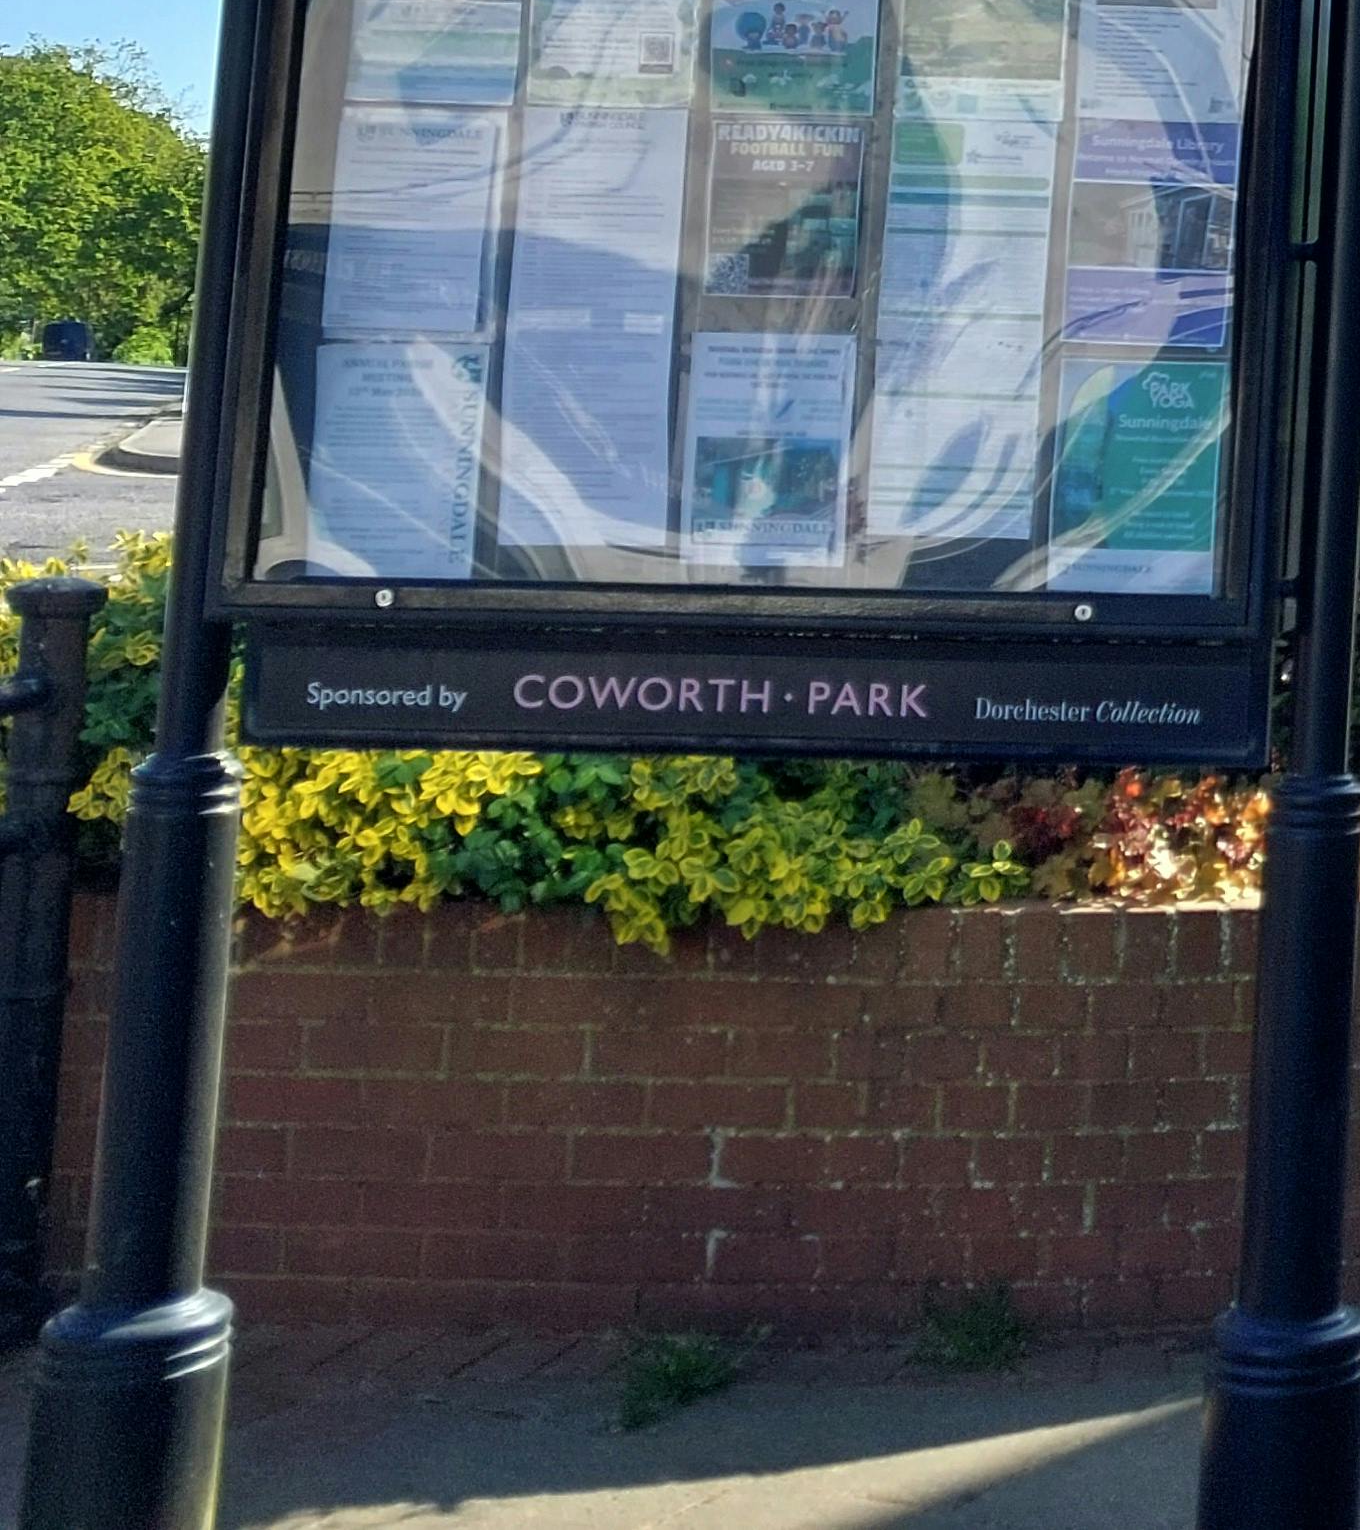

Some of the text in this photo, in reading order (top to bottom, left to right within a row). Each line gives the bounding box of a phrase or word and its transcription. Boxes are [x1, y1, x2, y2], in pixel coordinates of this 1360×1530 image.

[730, 142, 844, 157] FOOTBALL FUN
[1150, 380, 1193, 396] PARK
[1150, 393, 1196, 410] YOGA
[1118, 412, 1213, 433] Sunningdale
[306, 674, 928, 719] Sponsored by COWORTH PARK
[974, 694, 1202, 727] Dorchester Collection
